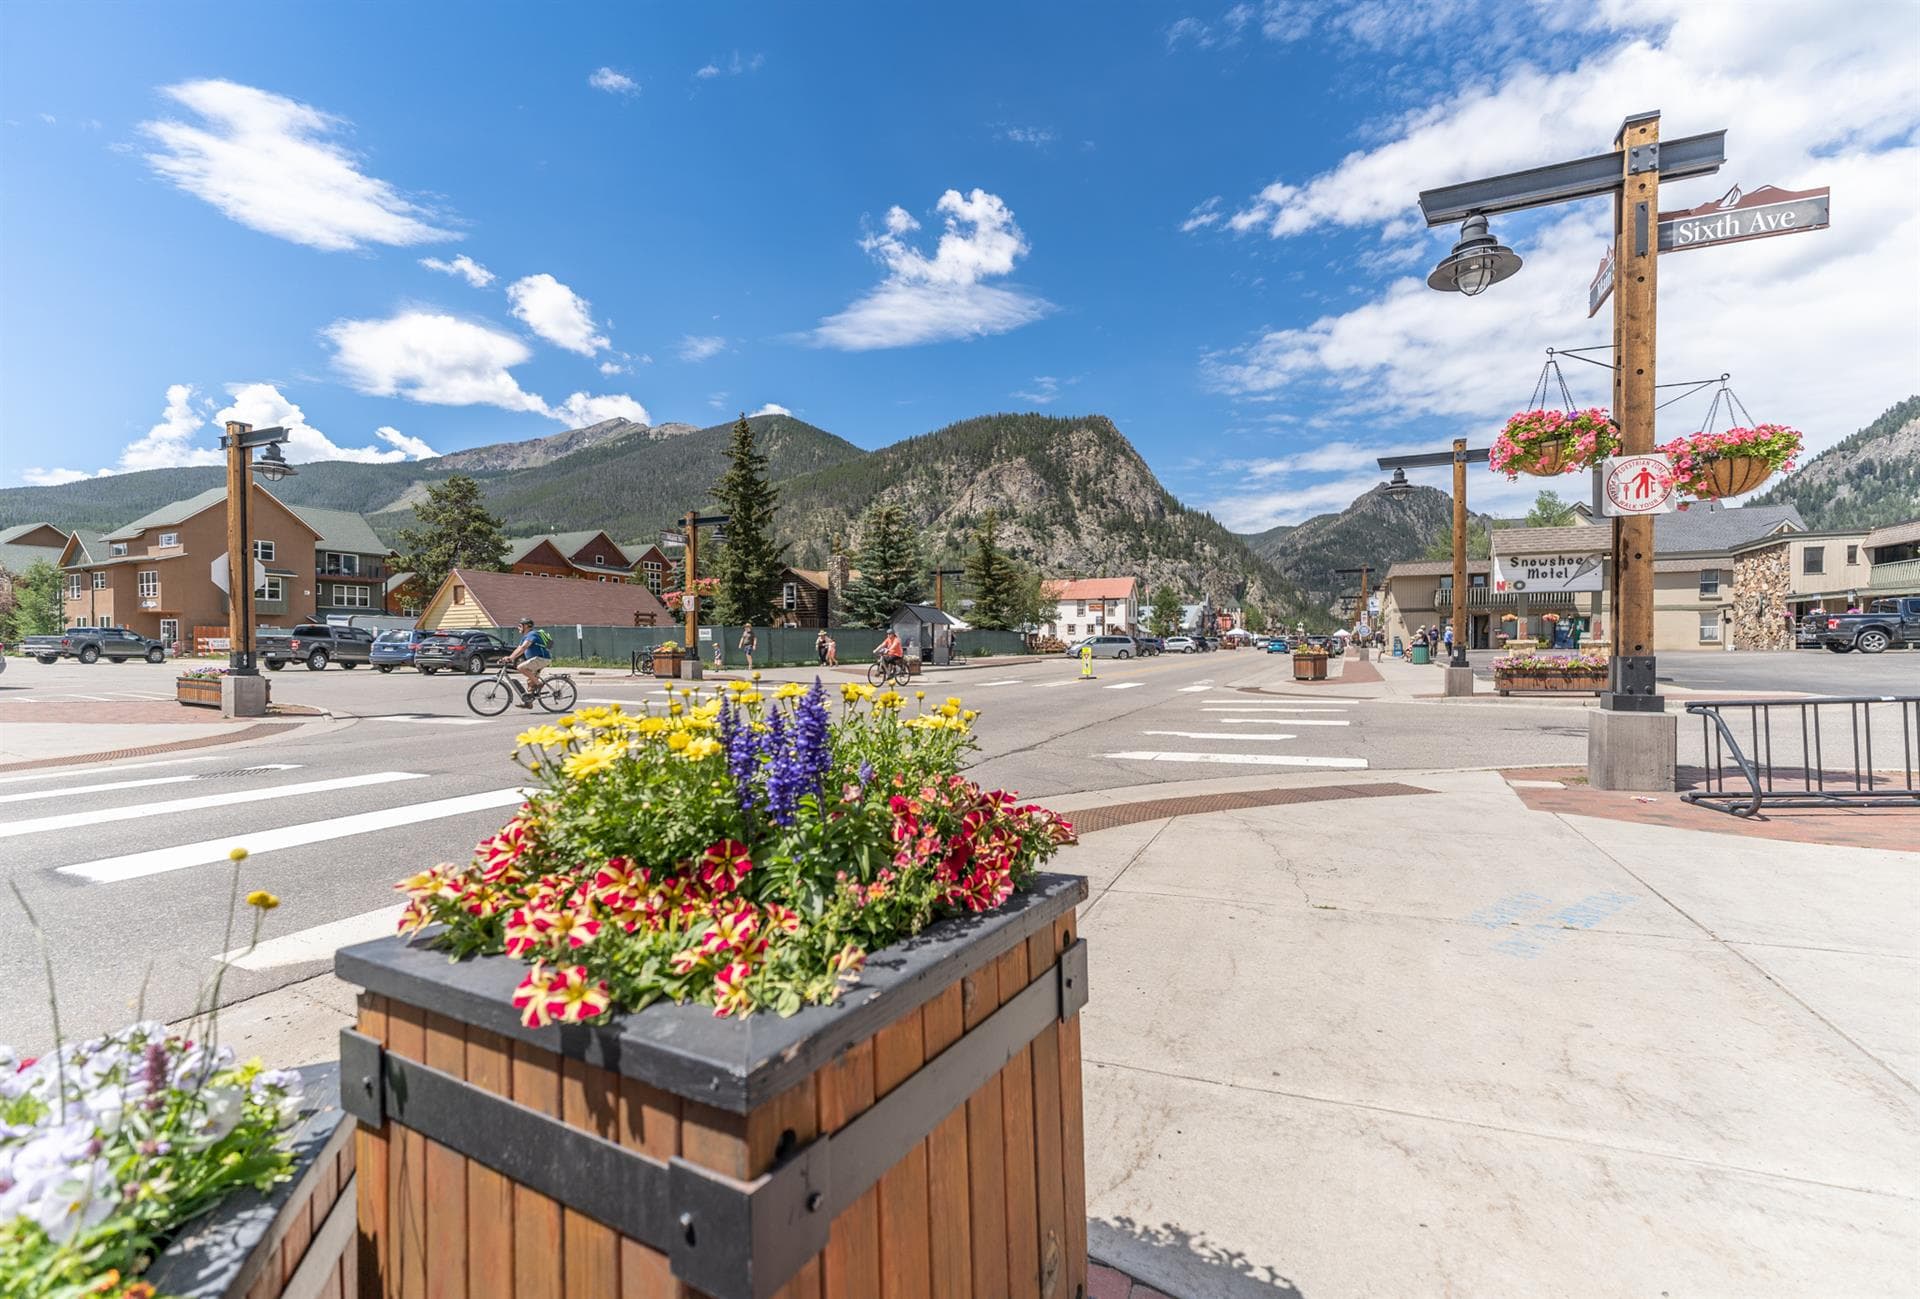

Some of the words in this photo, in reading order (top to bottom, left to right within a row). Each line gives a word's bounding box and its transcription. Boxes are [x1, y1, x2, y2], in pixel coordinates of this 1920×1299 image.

[1678, 214, 1741, 244] Sixth
[1749, 210, 1796, 233] Ave
[1618, 500, 1636, 509] WALK
[1640, 498, 1659, 509] YOUR
[1510, 555, 1583, 567] Snowshoe
[1527, 567, 1568, 579] Motel
